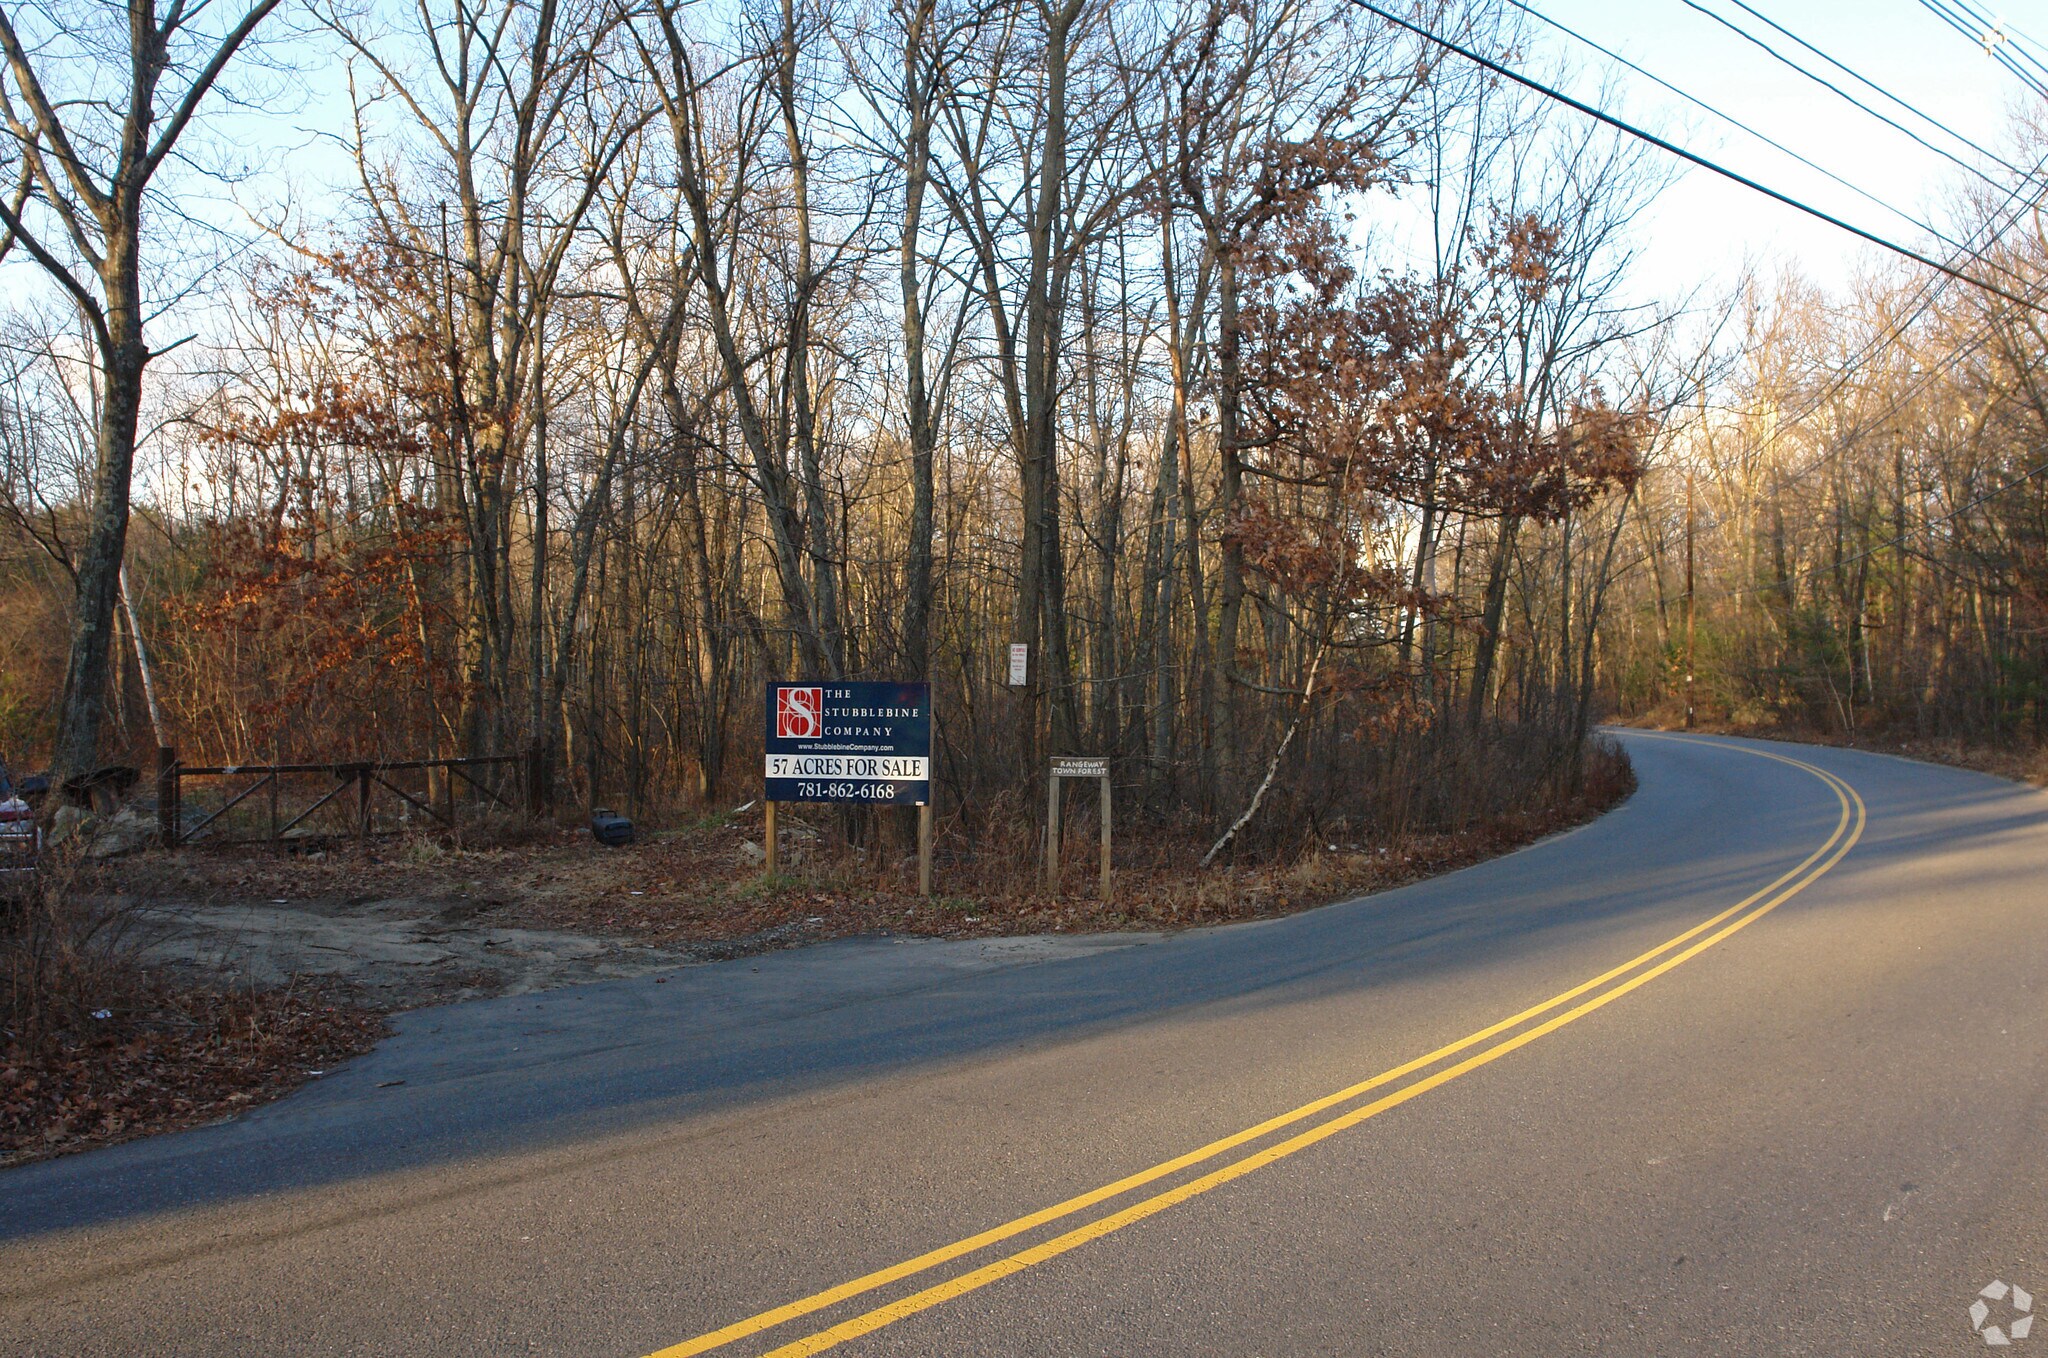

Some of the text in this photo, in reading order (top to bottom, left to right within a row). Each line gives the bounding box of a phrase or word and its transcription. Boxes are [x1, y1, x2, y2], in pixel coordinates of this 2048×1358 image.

[825, 689, 851, 699] THE
[825, 708, 919, 718] STUBBLEBINE
[824, 727, 893, 736] COMPANY
[798, 743, 894, 752] www.StubblebineCompany.com
[772, 758, 922, 777] 57 ACRES FOR SALE
[1077, 767, 1107, 775] FOREST
[798, 782, 895, 799] 781-862-6168
